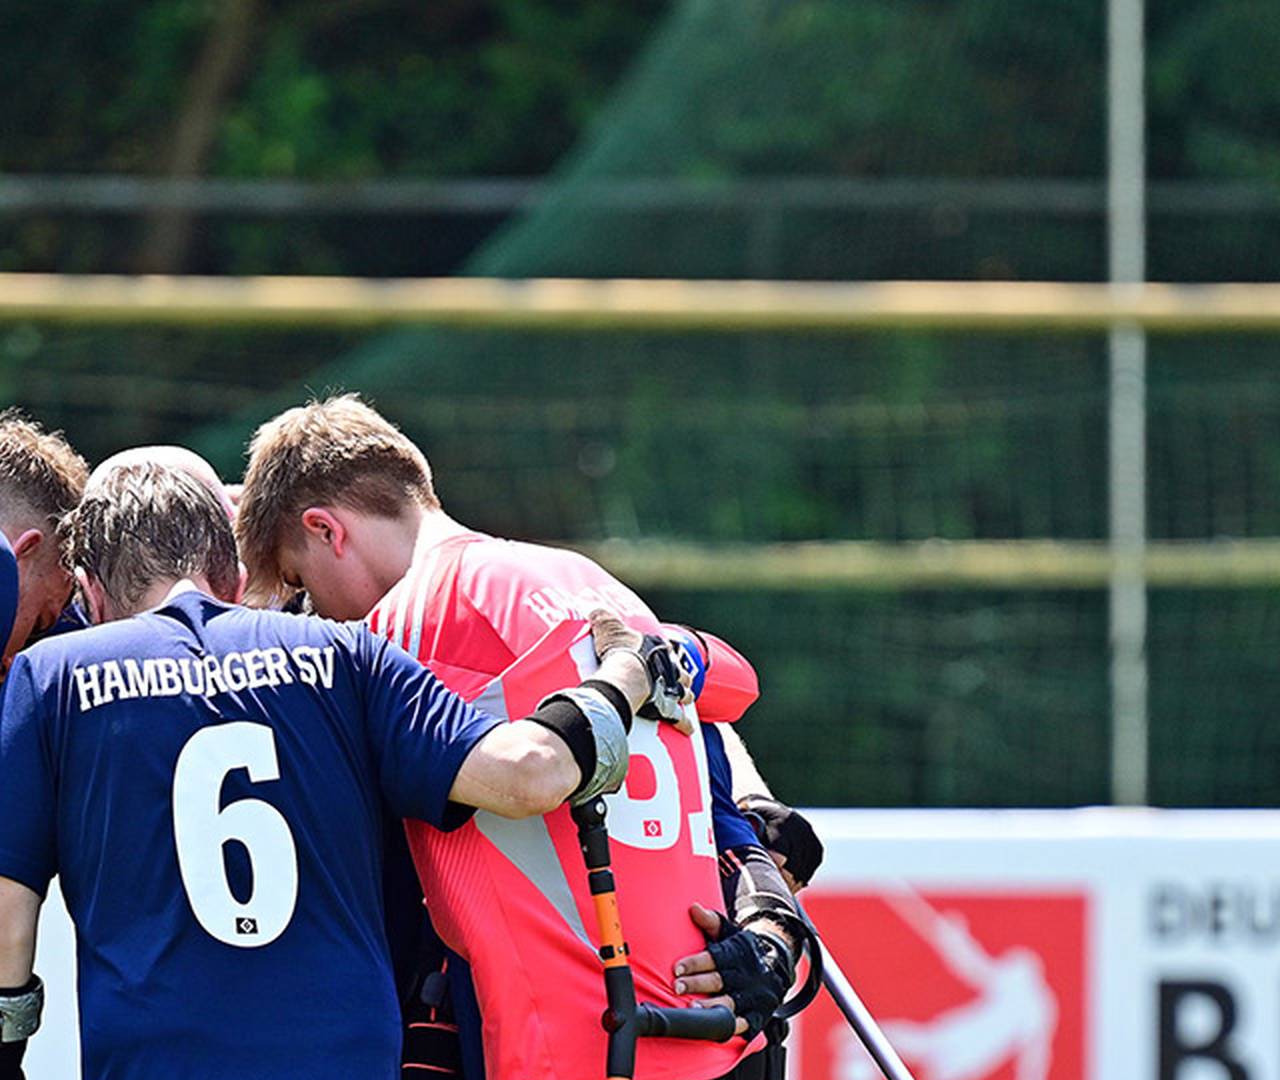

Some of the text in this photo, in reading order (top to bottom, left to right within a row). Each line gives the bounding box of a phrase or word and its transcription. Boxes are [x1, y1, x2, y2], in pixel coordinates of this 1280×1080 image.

[74, 646, 335, 711] HAMBURGER SV
[173, 721, 298, 947] 6
